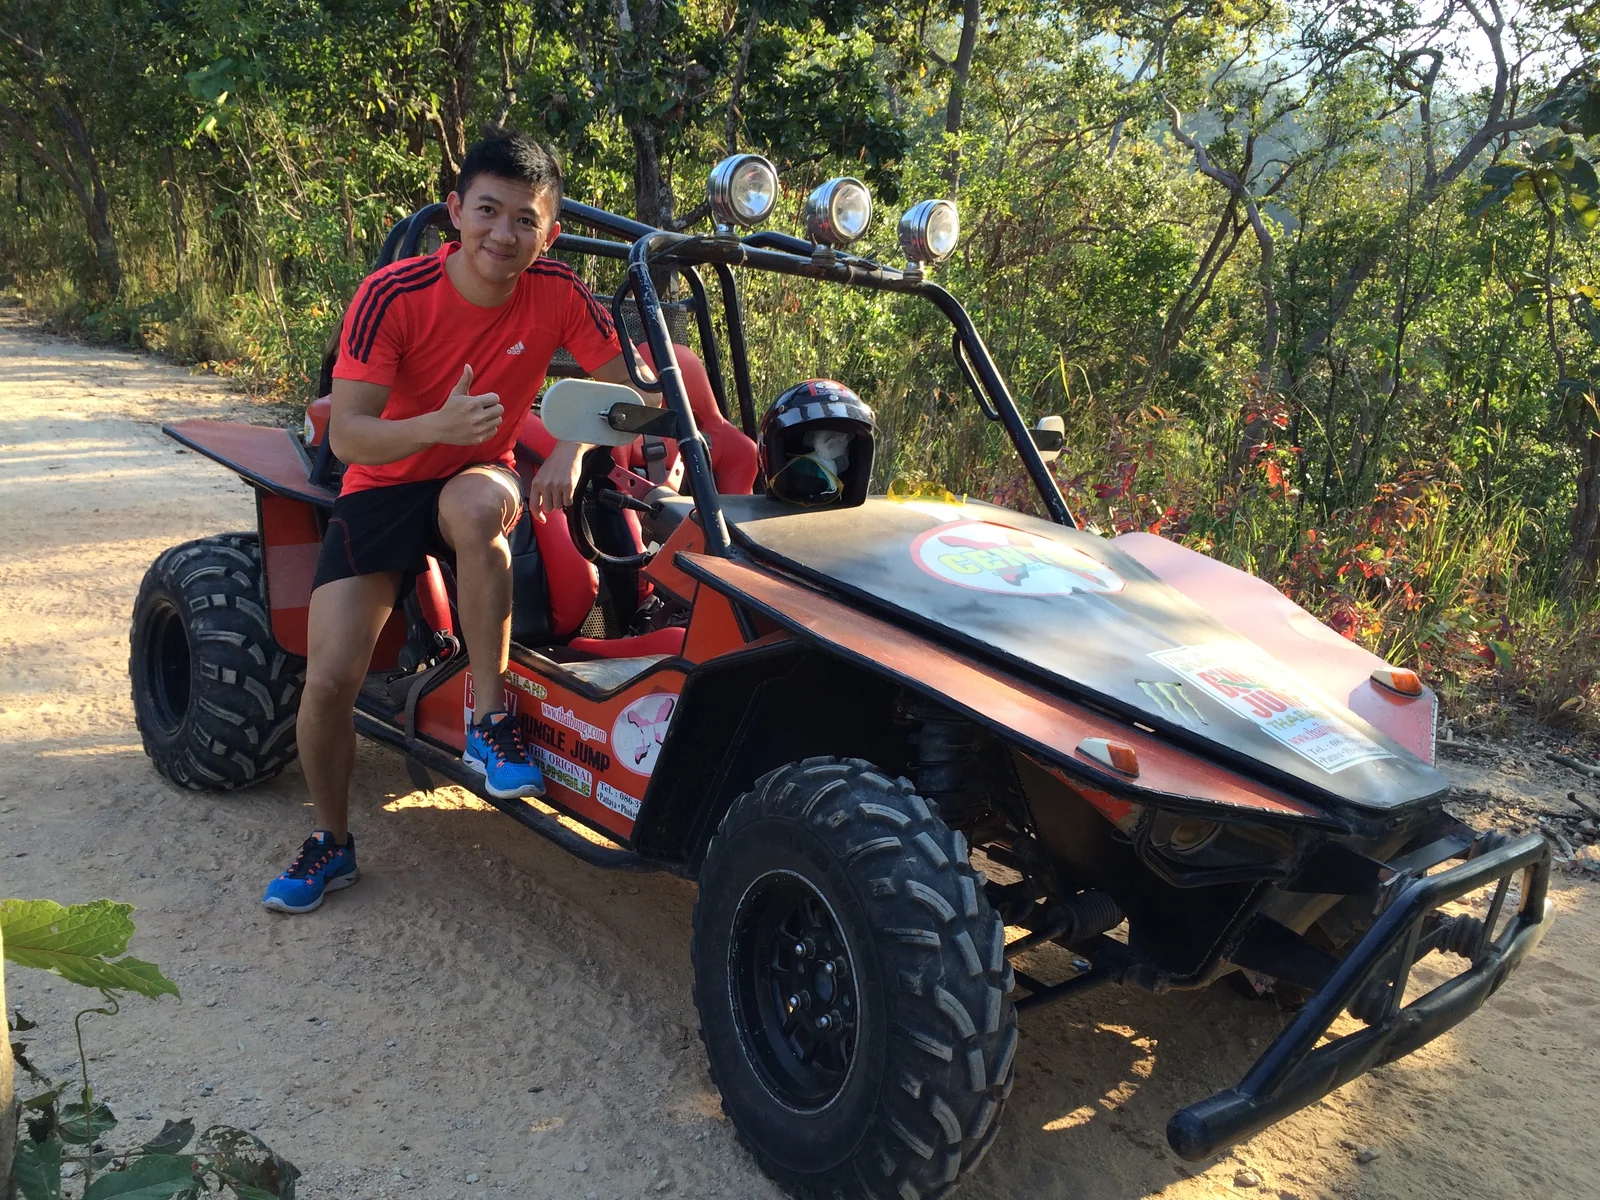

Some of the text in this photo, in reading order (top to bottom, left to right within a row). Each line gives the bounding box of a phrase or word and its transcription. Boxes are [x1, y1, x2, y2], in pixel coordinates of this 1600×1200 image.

[506, 670, 547, 699] AILAND
[530, 743, 592, 784] THE ORIGINAL
[570, 740, 610, 773] JUMP
[600, 781, 613, 795] Tel.
[620, 803, 637, 819] Phuke
